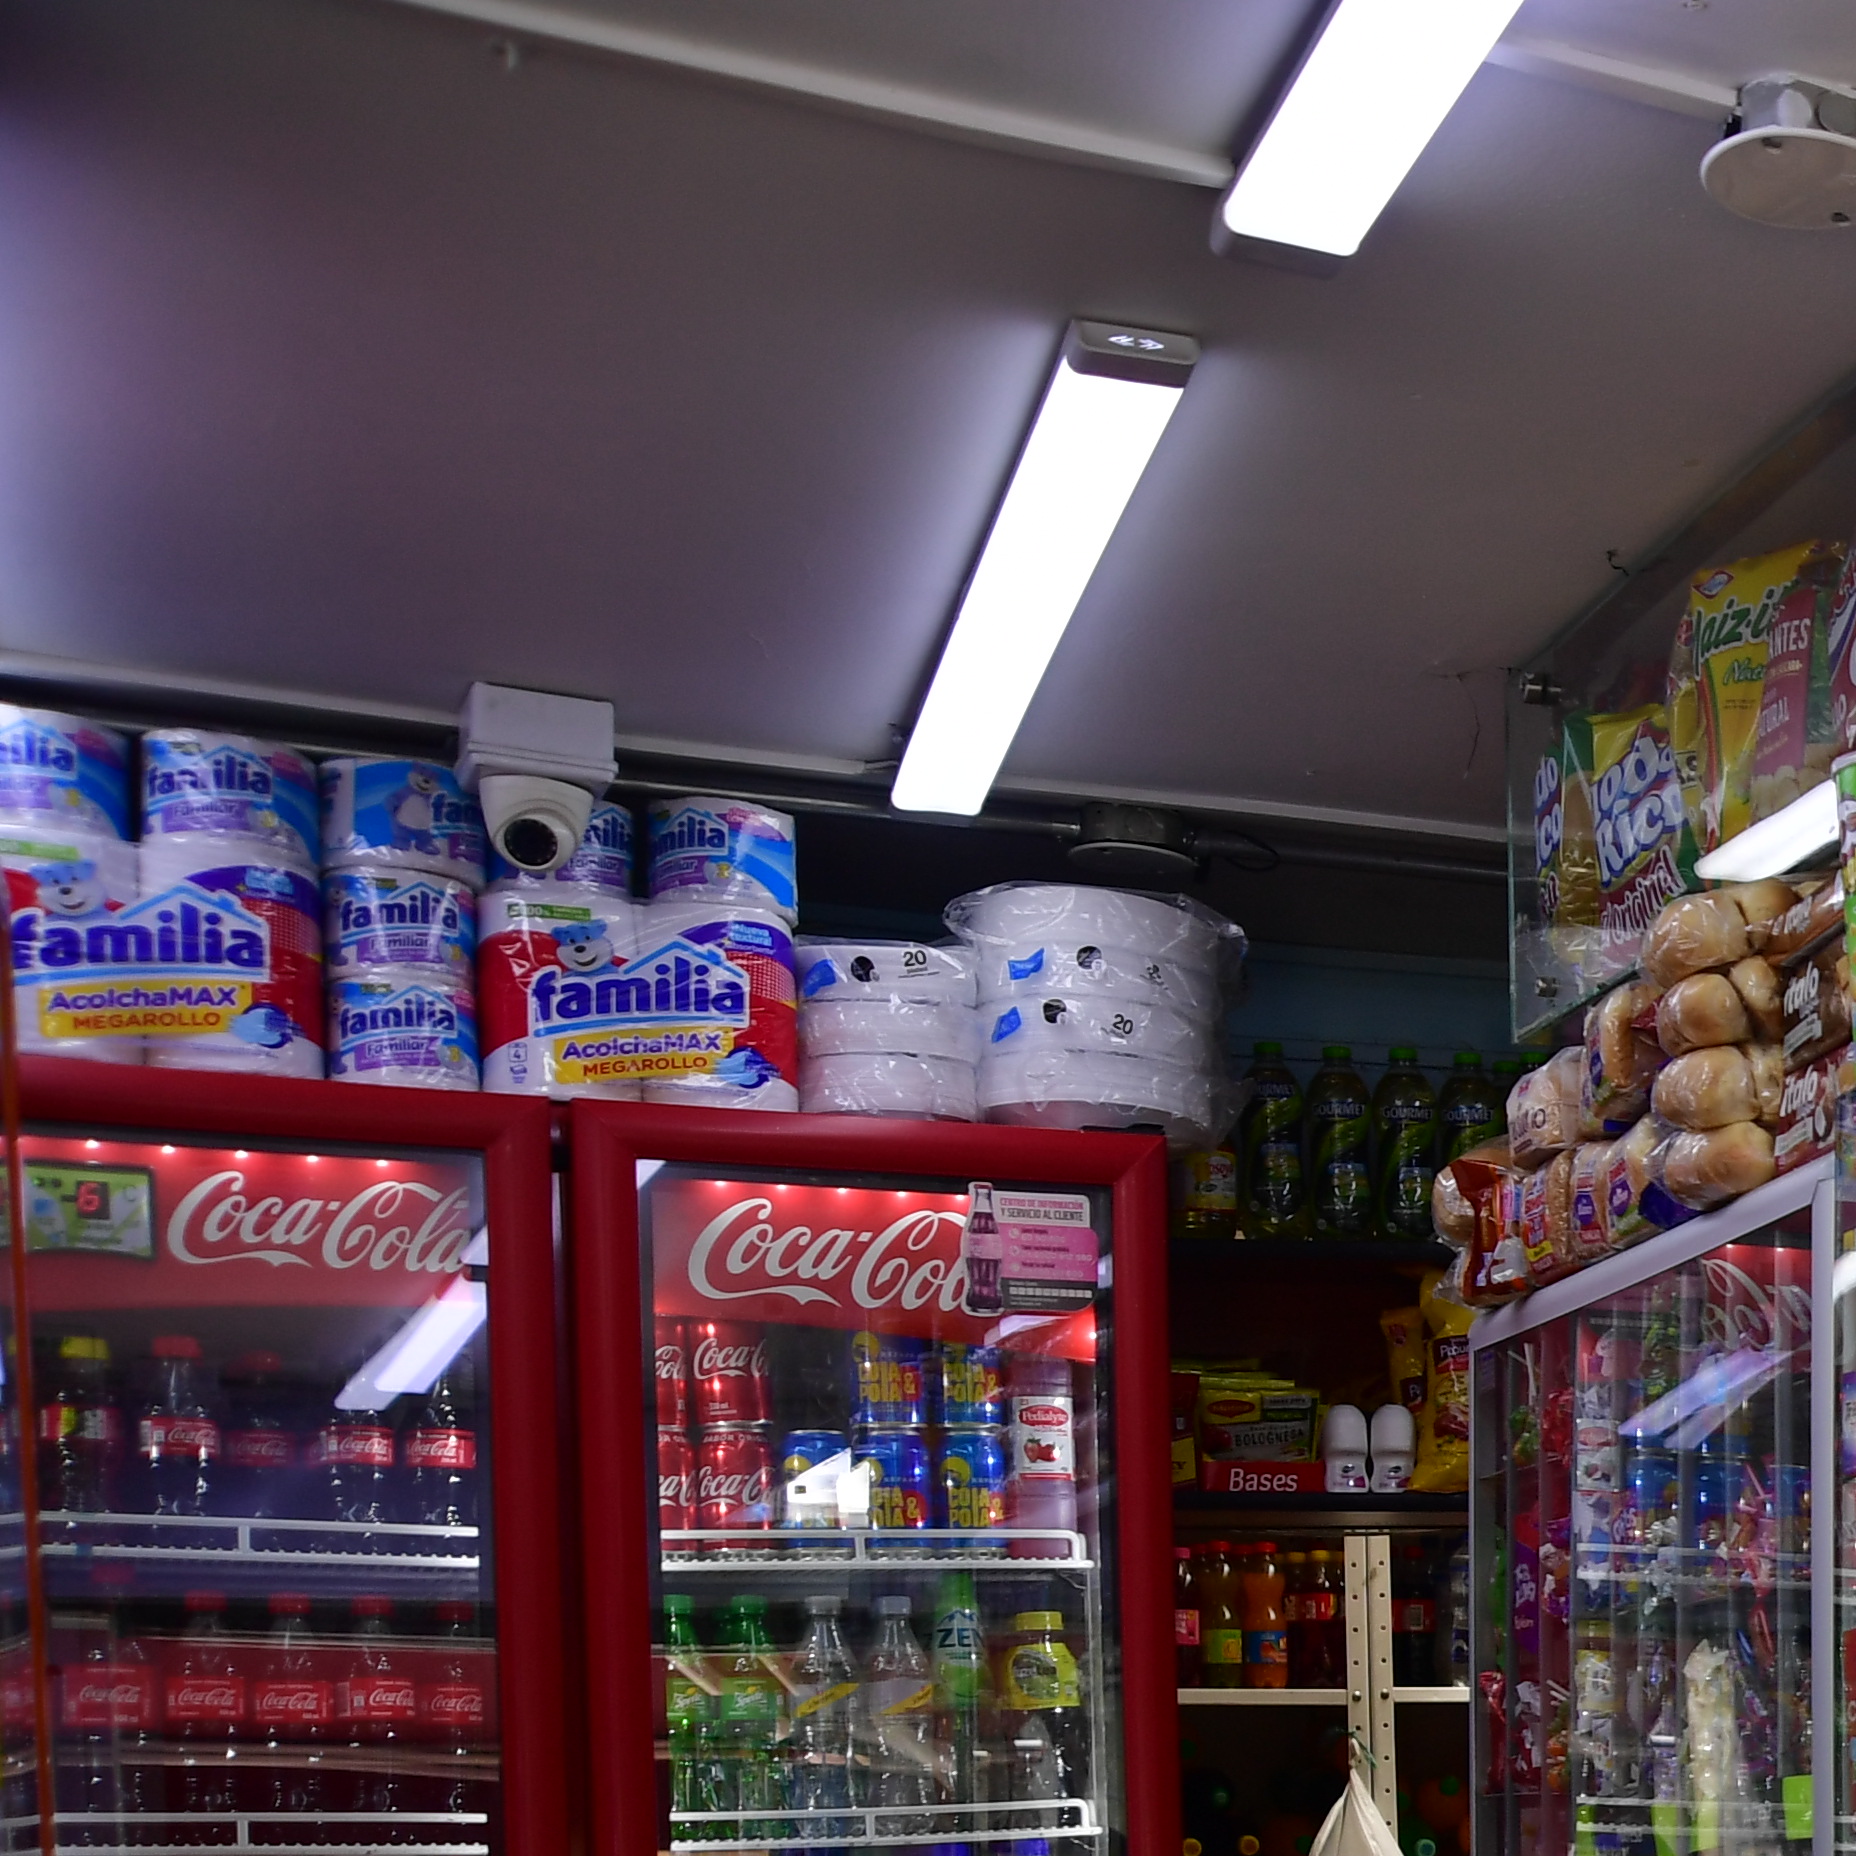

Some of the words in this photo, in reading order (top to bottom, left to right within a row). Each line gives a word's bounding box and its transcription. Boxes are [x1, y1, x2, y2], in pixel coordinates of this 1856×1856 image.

[10, 901, 268, 970] familia
[49, 984, 238, 1013] AcolchaMAX
[533, 966, 747, 1023] familia
[72, 1010, 222, 1031] MEGAROLLO
[339, 994, 456, 1040] familia
[561, 1031, 722, 1060] AcolchaMAX
[582, 1056, 708, 1078] MEGAROLLO
[167, 1170, 472, 1276] Coca-Cola
[1229, 1468, 1299, 1492] Bases
